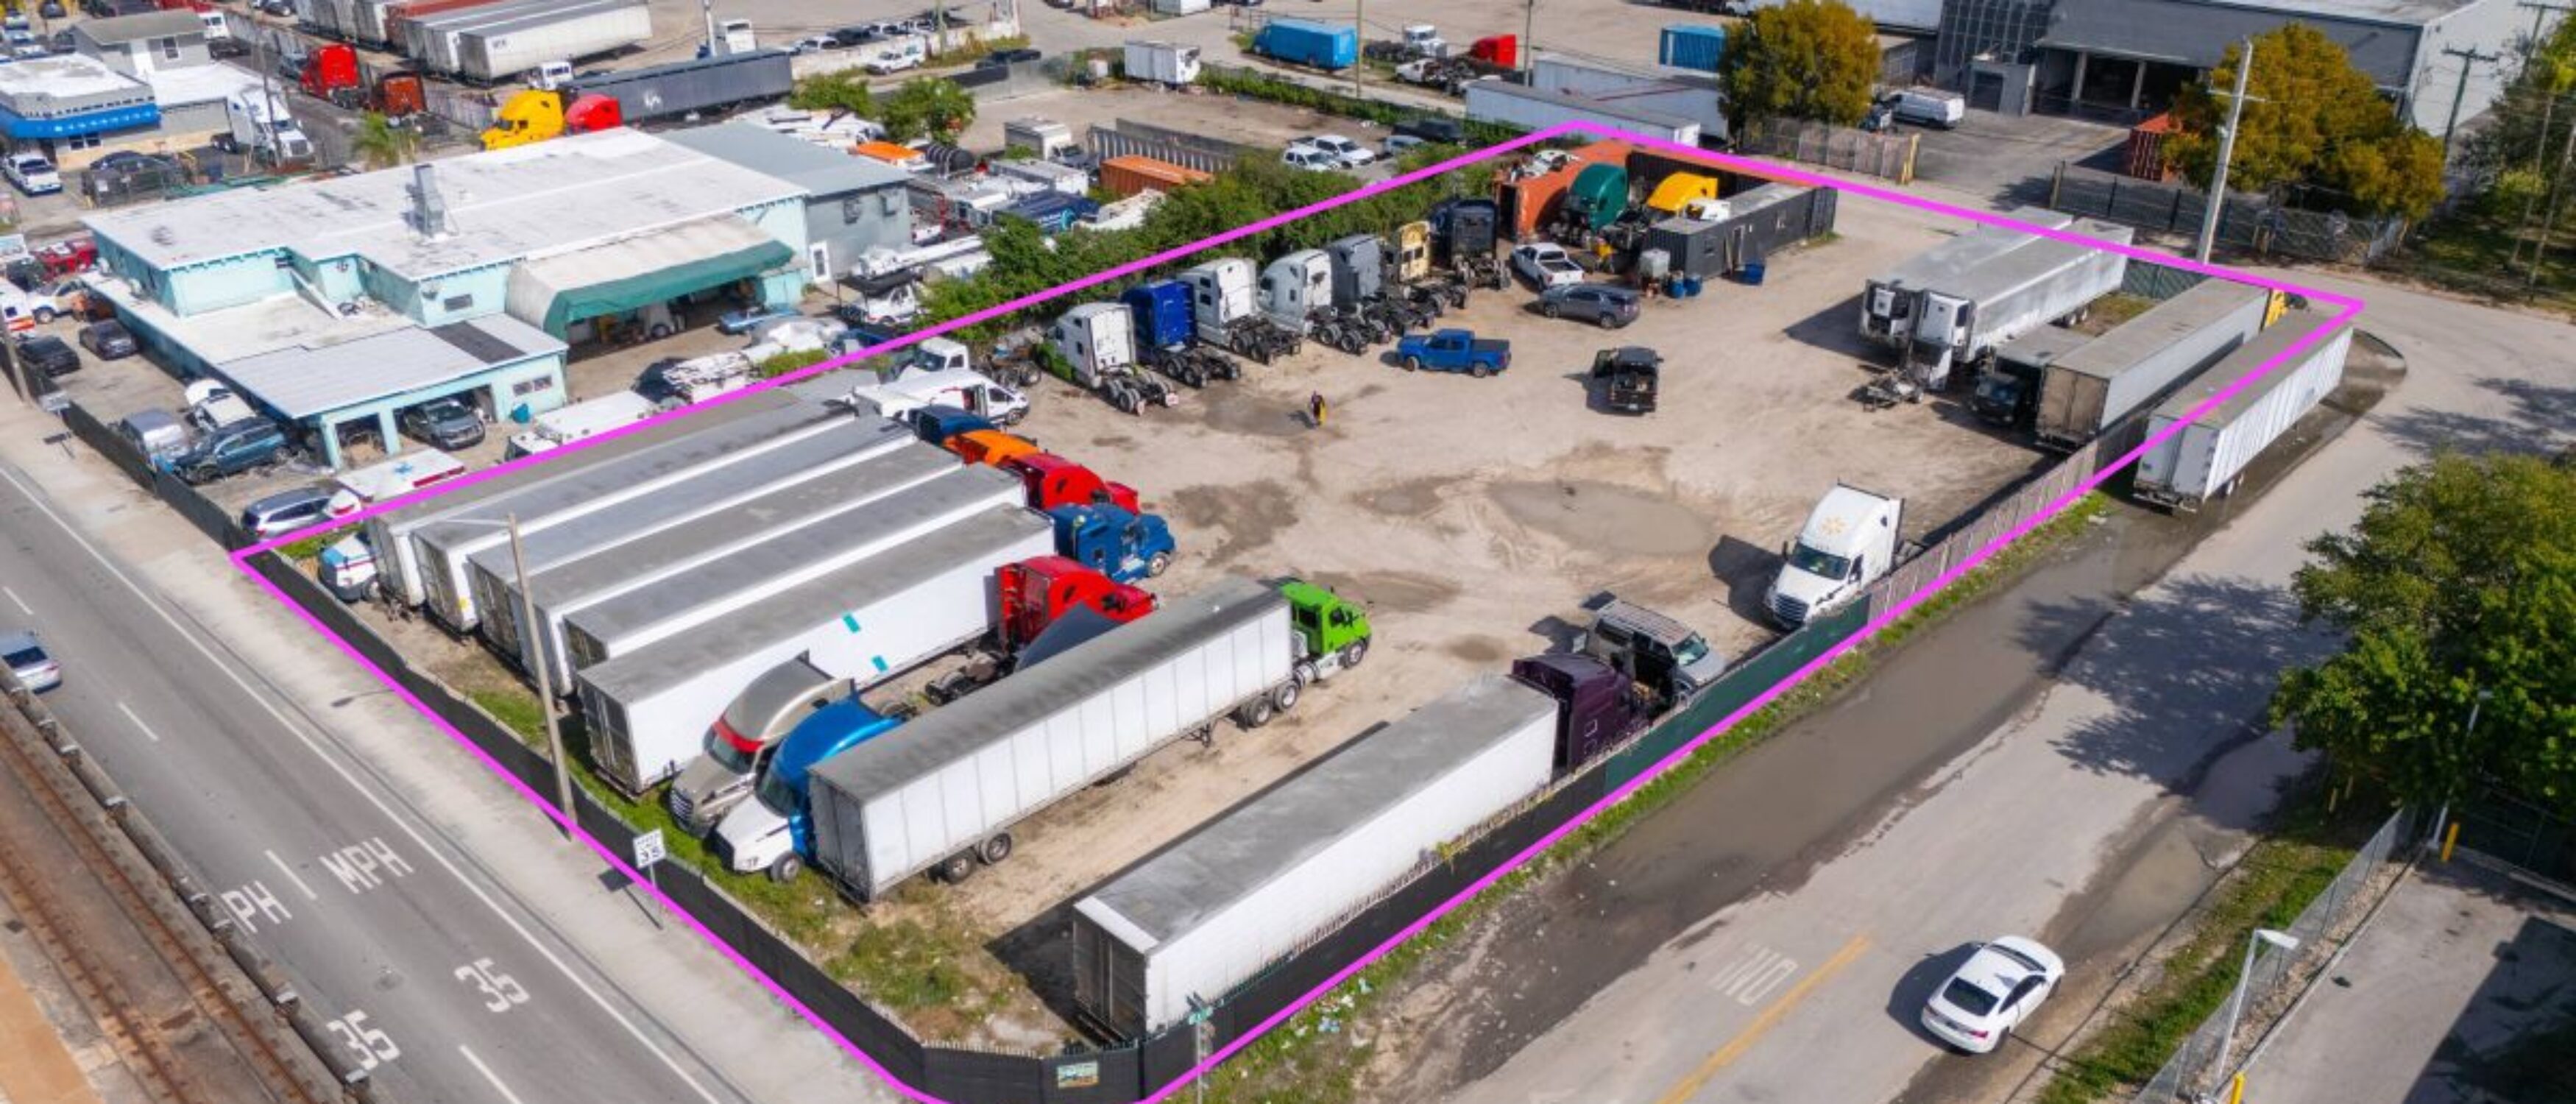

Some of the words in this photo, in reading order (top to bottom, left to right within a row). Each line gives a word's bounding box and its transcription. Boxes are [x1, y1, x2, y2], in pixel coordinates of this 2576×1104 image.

[318, 837, 414, 894] MPH
[220, 880, 292, 933] PH
[454, 957, 530, 1013] 35
[326, 1009, 400, 1070] 35
